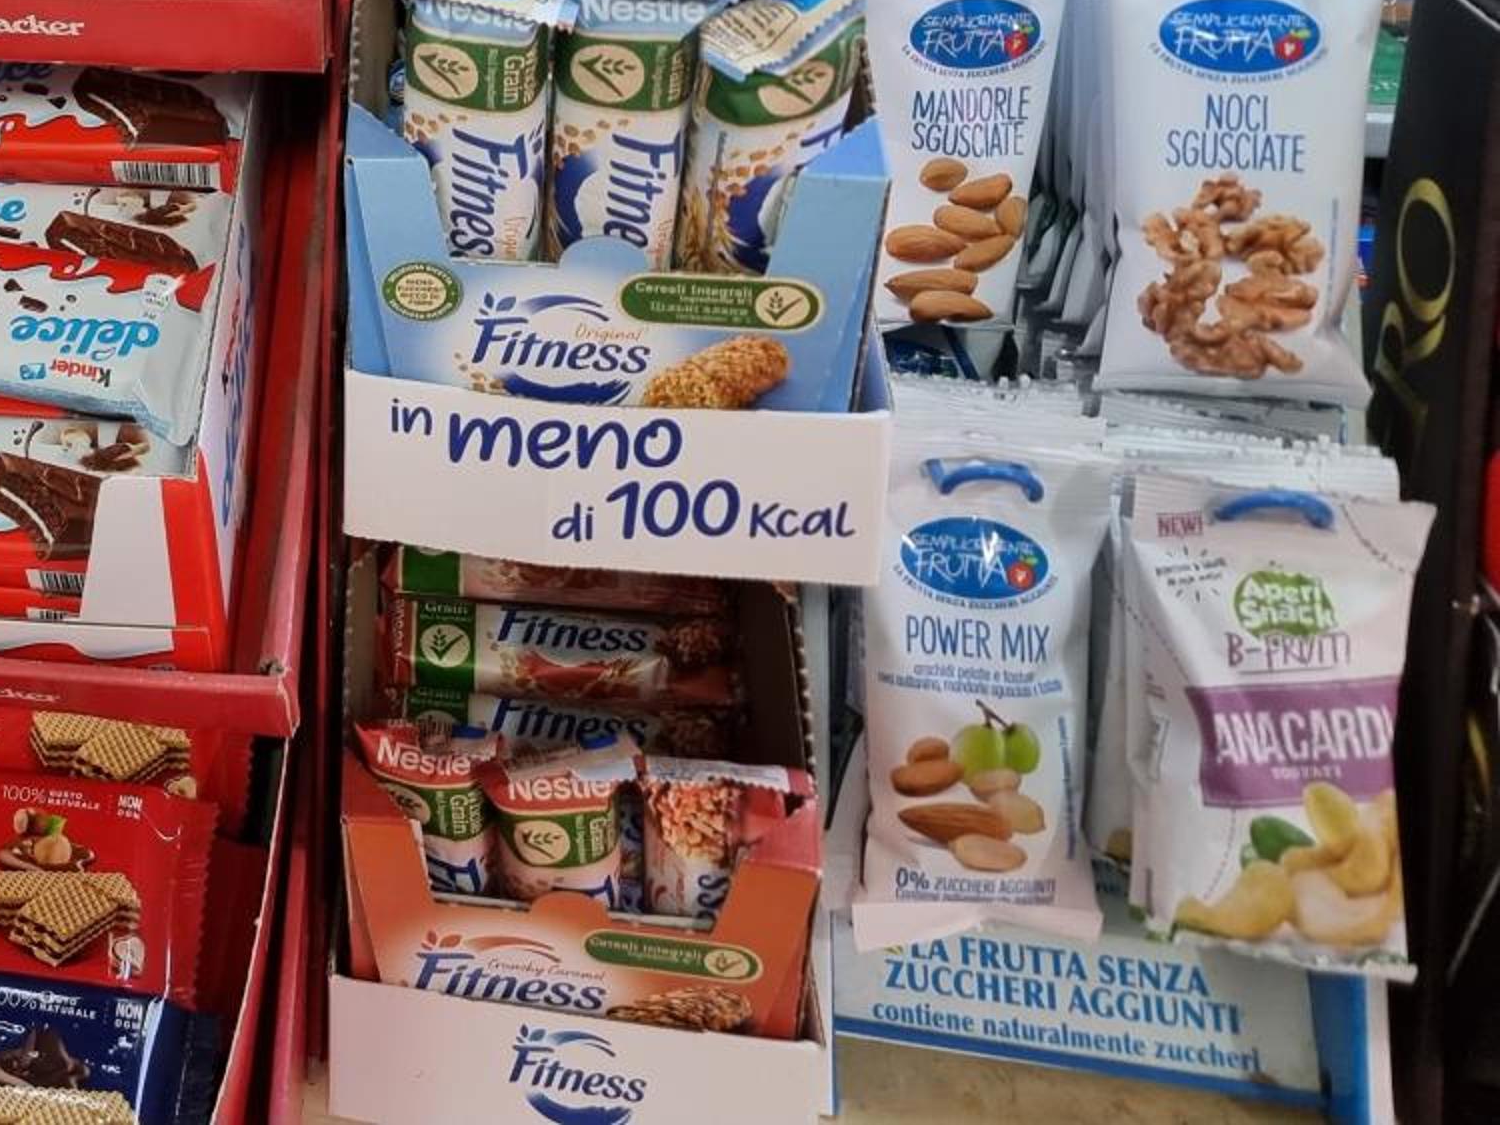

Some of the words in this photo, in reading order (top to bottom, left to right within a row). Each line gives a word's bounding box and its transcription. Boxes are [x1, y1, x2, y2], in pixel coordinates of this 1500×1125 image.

[923, 28, 1005, 59] FRUTTA
[1174, 26, 1276, 62] FRUTTA
[503, 54, 524, 105] Grain
[911, 85, 1031, 123] MANDORLE
[1205, 94, 1269, 132] NOCI
[911, 121, 1025, 159] SGUSCIATE
[1165, 129, 1306, 173] SGUSCIATE
[605, 131, 682, 249] Fitne
[471, 318, 651, 374] Fitness
[574, 323, 642, 342] Original
[51, 359, 112, 387] Kinder
[390, 398, 432, 435] in
[447, 417, 683, 470] meno
[552, 504, 593, 541] di
[605, 480, 741, 540] 100
[749, 501, 855, 539] Kcal
[914, 547, 1010, 588] FRUTTA
[1241, 574, 1324, 602] Aperi
[497, 606, 650, 652] Fitness
[1239, 600, 1340, 629] Snack
[906, 615, 991, 659] POWER
[1001, 623, 1050, 663] MIX
[2, 784, 47, 805] 100%
[118, 795, 143, 811] NON
[48, 797, 102, 811] NATURALE
[895, 867, 930, 892] 0%
[934, 876, 996, 894] ZUCCHERI
[999, 877, 1056, 894] AGGIUNTI
[414, 951, 608, 1010] Fitness
[911, 937, 949, 963] LA
[960, 936, 1088, 981] FRUTTA
[1099, 955, 1211, 997] SENZA
[38, 1002, 98, 1020] NATURALE
[115, 1000, 144, 1020] NON
[885, 959, 1057, 1011] ZUCCHERI
[1068, 986, 1243, 1035] AGGIUNTI
[873, 999, 974, 1033] contiene
[982, 1017, 1152, 1056] naturalmente
[1154, 1036, 1261, 1073] zuccheri
[507, 1044, 648, 1103] Fitness
